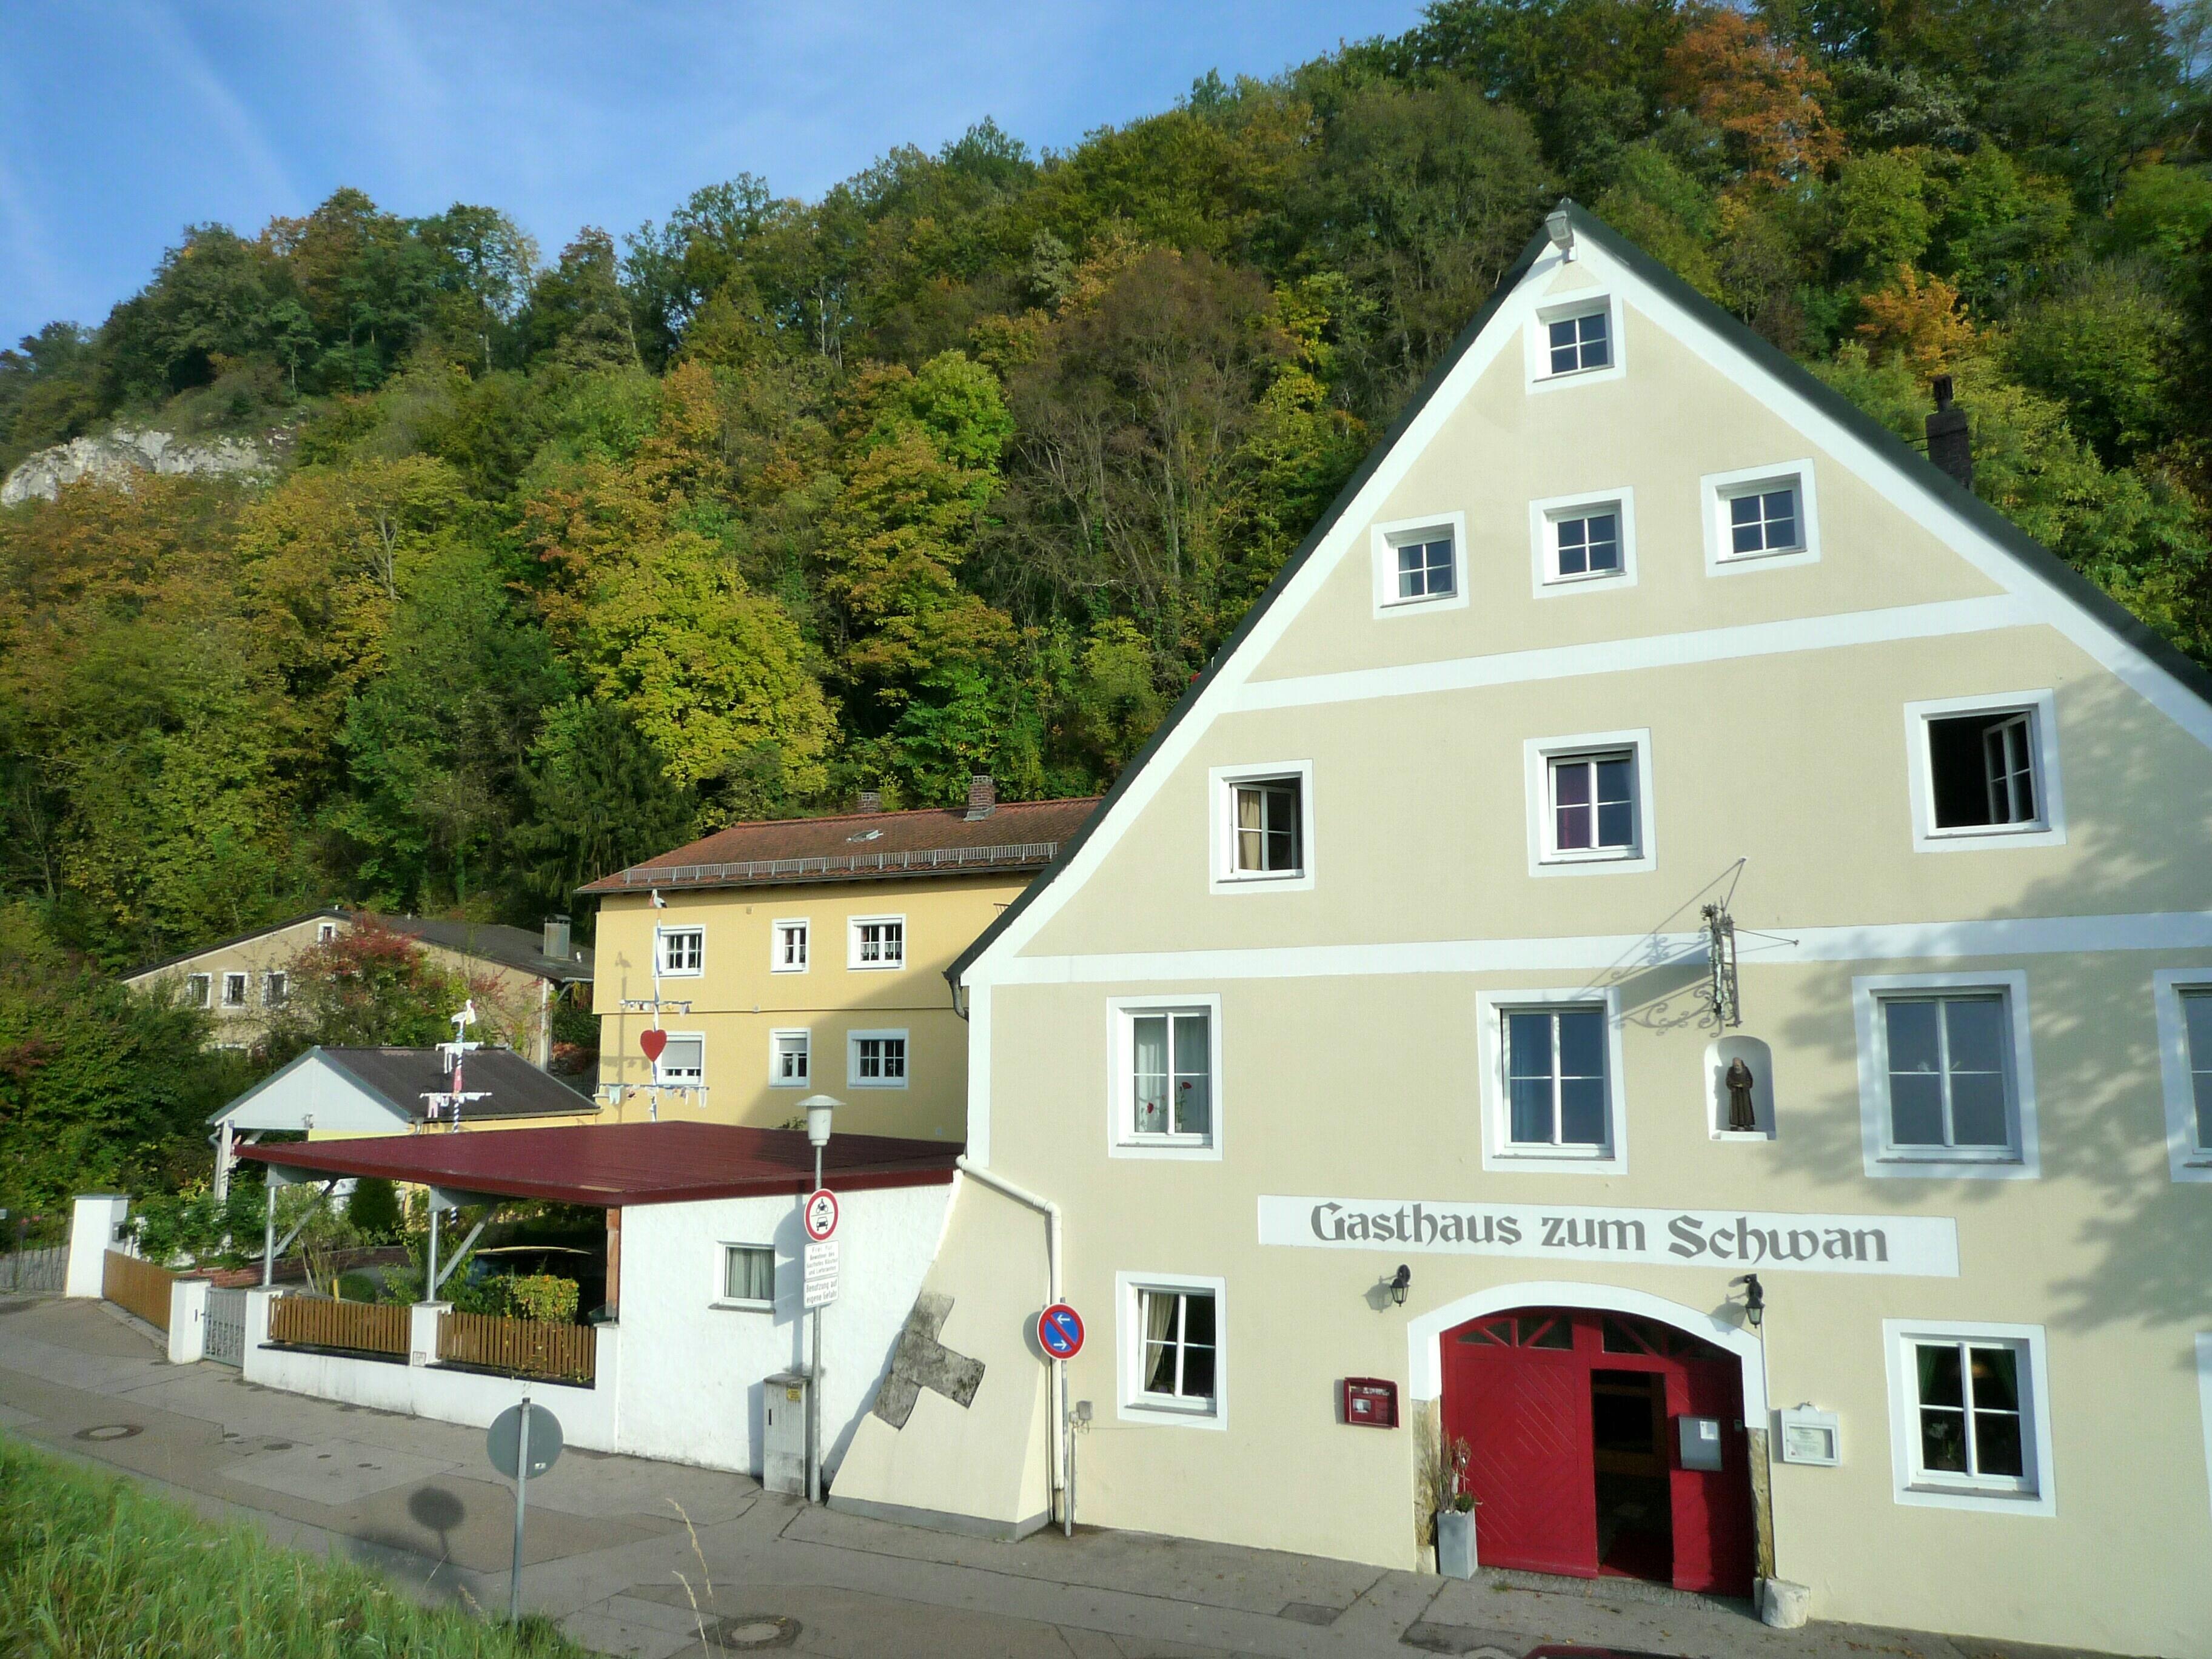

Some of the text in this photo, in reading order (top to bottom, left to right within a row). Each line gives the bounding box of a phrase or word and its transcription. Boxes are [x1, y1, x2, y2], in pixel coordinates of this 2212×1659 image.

[1311, 1202, 1888, 1264] Gasthaus zum Schwan
[806, 1282, 829, 1293] Benutzung
